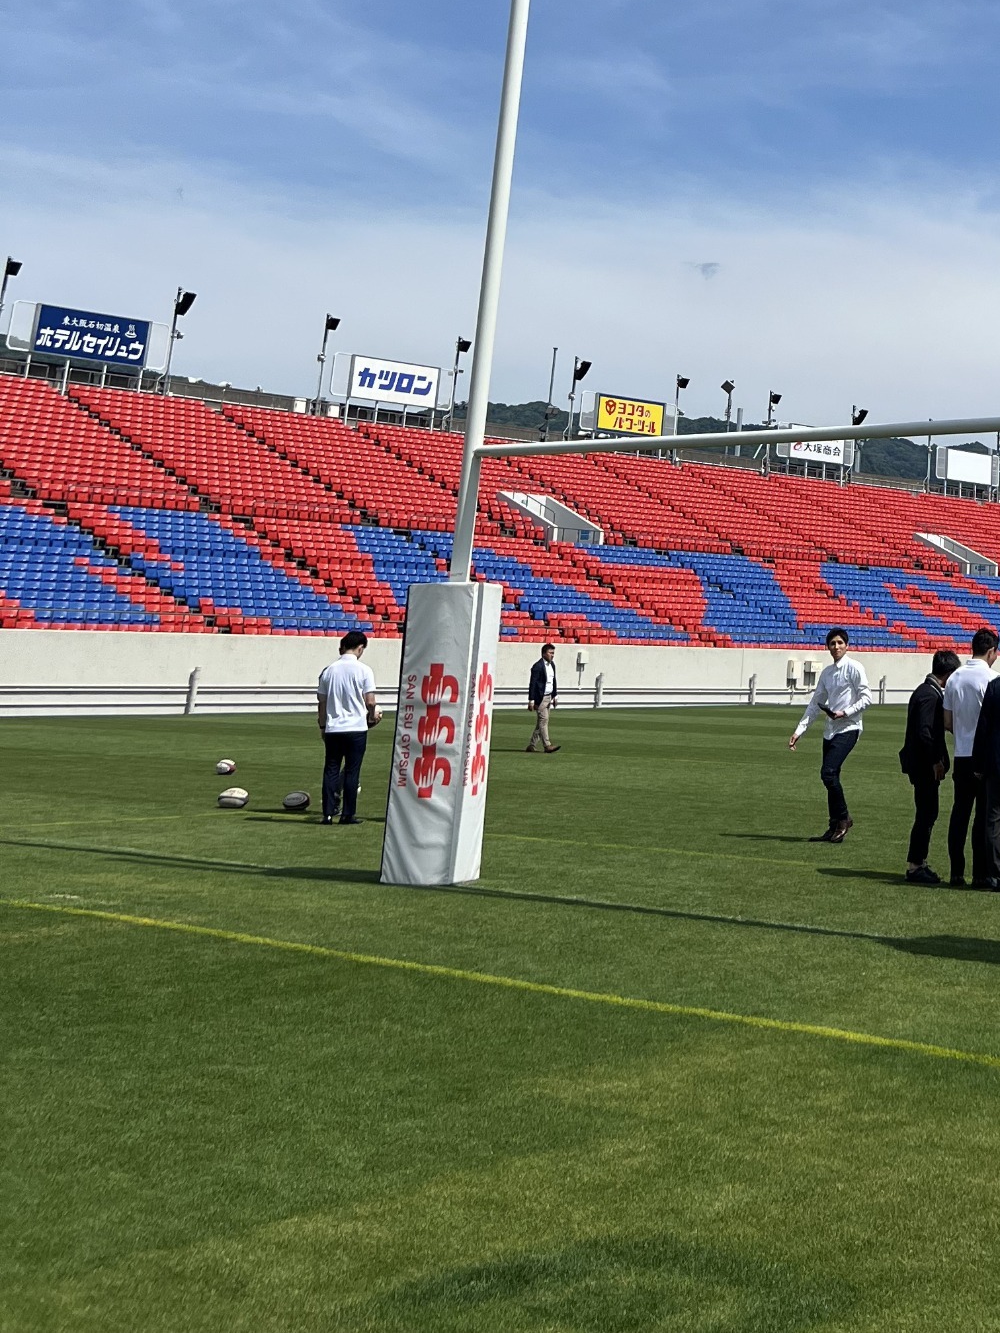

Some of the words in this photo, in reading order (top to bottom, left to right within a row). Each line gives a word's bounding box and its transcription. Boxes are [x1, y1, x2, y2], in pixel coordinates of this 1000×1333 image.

[62, 316, 120, 333] 東大阪石切温泉
[36, 327, 144, 360] ホテルセイリュウ
[358, 367, 432, 396] カツロン
[618, 402, 651, 418] ヨコタの
[804, 443, 841, 456] 大塚商会
[406, 674, 417, 700] SAN
[403, 704, 414, 729] ESU
[397, 733, 411, 787] GYPSUM
